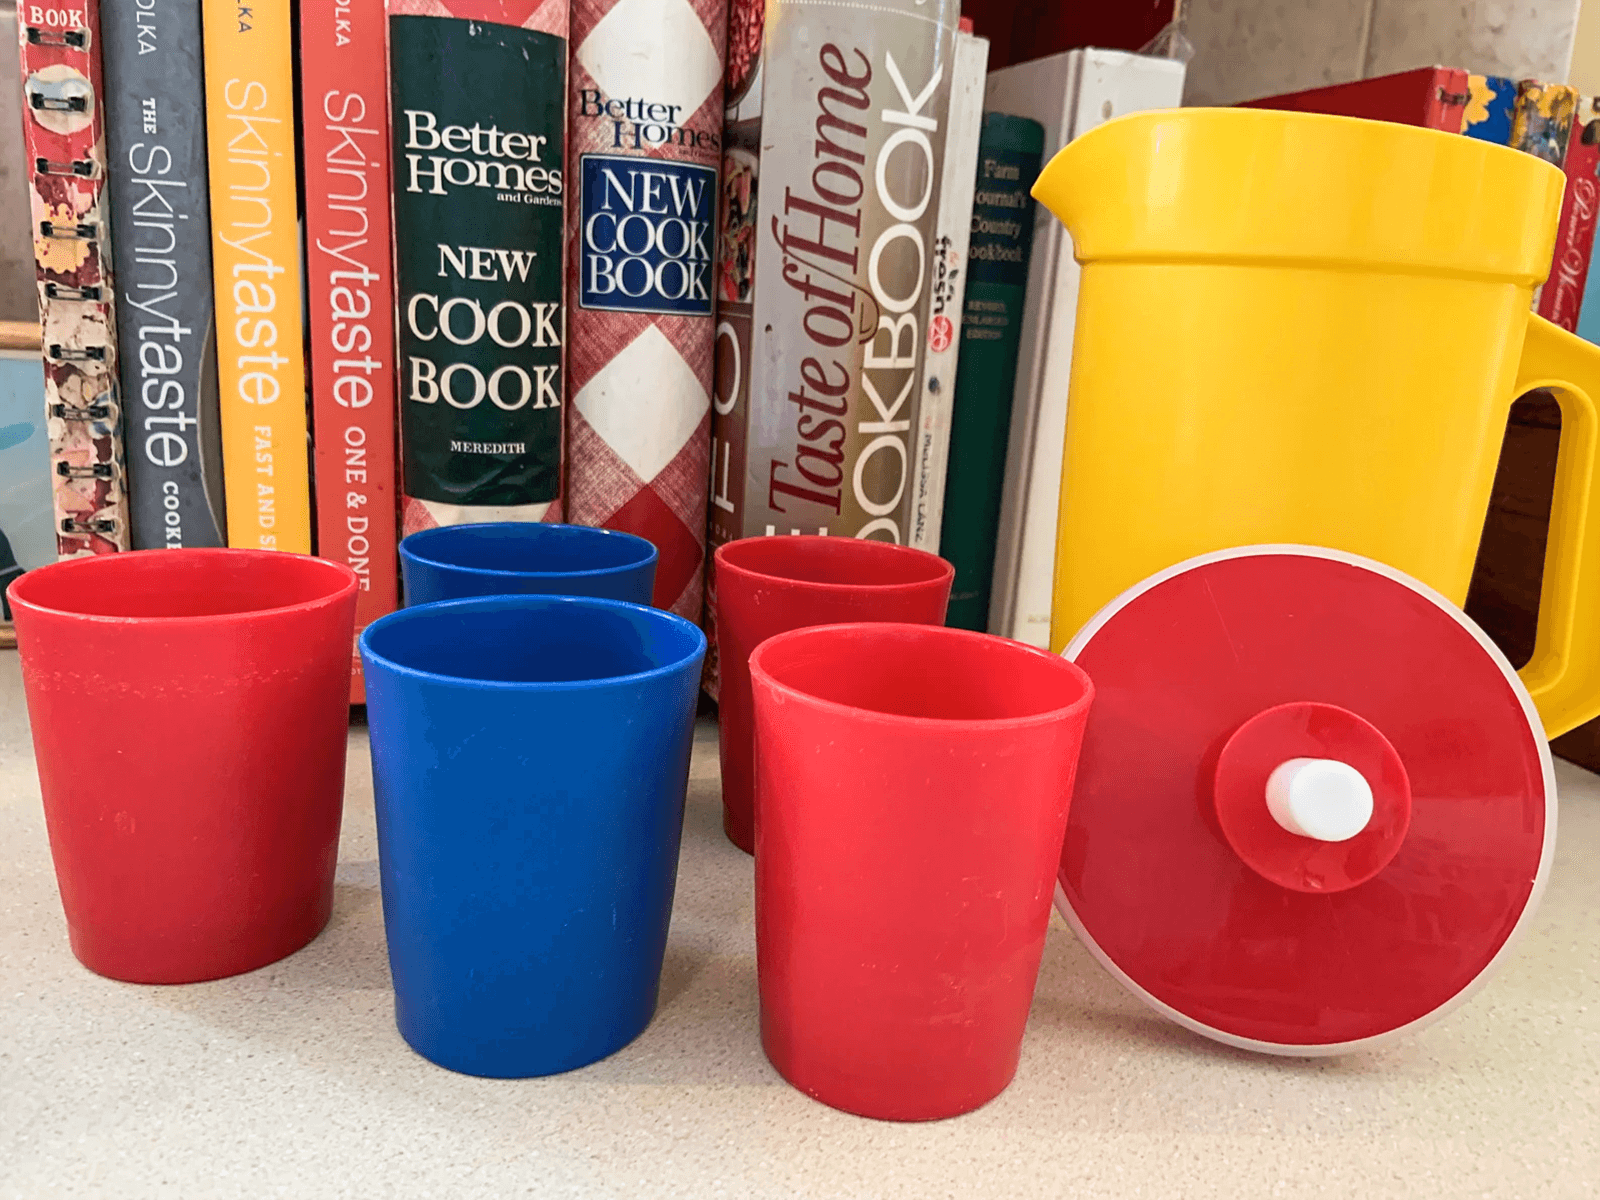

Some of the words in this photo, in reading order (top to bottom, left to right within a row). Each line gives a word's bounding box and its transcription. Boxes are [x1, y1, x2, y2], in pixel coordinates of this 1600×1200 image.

[30, 4, 84, 28] BOOK
[236, 0, 253, 33] KA
[142, 98, 157, 134] THE
[580, 88, 681, 124] Better
[404, 109, 547, 162] Better
[611, 121, 720, 150] Homes
[784, 43, 872, 275] Home
[405, 153, 562, 196] Homes
[496, 192, 523, 204] and
[601, 168, 706, 218] NEW
[219, 78, 289, 405] Skinnytaste
[316, 90, 383, 409] Skinnytaste
[585, 212, 711, 262] COOK
[437, 243, 537, 283] NEW
[586, 254, 709, 301] BOOK
[126, 143, 198, 467] Skinnytaste
[407, 293, 562, 348] COOK
[782, 256, 856, 347] of
[408, 356, 561, 411] BOOK
[254, 425, 274, 476] FAST
[344, 426, 367, 484] ONE
[450, 440, 526, 455] MEREDITH
[768, 357, 850, 516] Taste
[257, 483, 276, 528] AND
[346, 491, 368, 509] &
